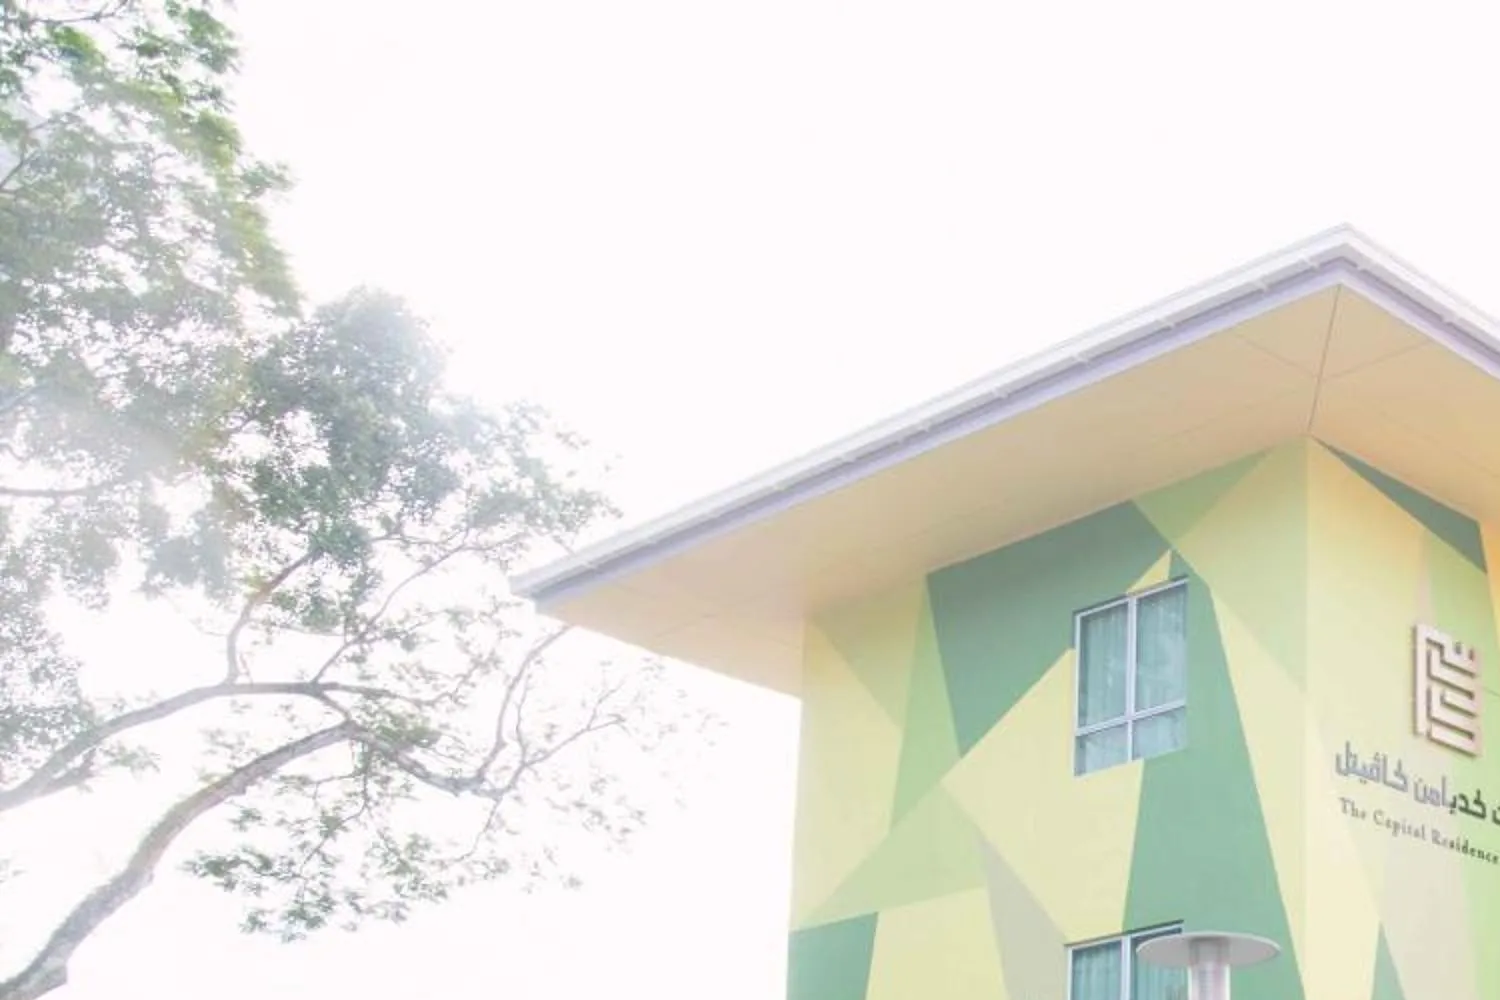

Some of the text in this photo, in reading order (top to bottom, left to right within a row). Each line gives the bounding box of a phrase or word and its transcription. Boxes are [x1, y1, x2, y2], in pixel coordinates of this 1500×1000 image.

[1338, 797, 1366, 819] The
[1373, 809, 1426, 840] Capital
[1431, 828, 1499, 864] Residence
